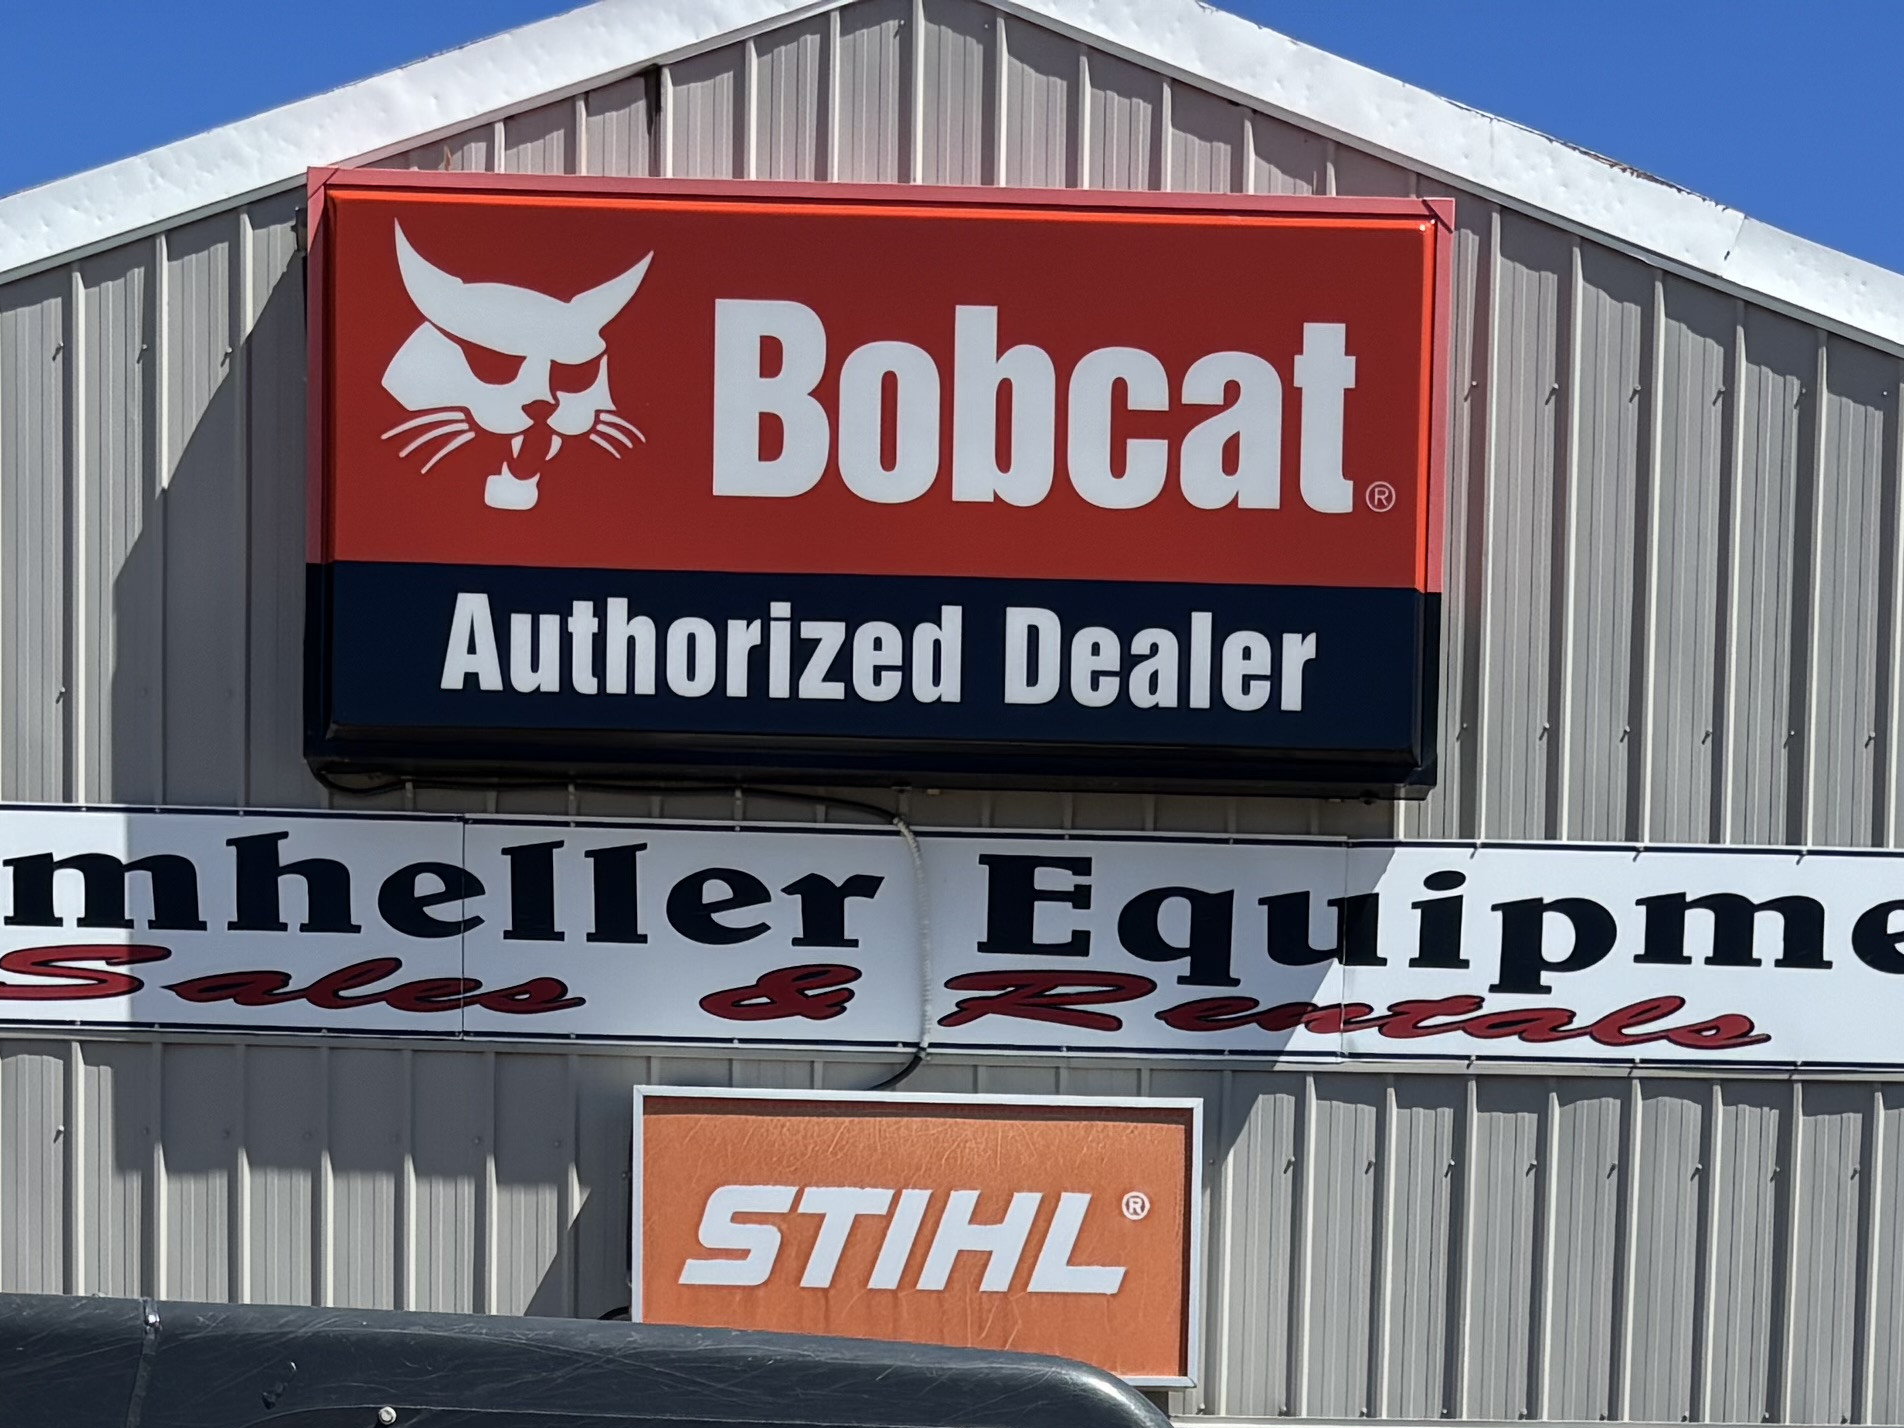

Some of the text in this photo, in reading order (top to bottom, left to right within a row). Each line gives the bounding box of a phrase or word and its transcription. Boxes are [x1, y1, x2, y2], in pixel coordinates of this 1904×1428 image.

[712, 298, 1356, 514] Bobcat
[440, 592, 1318, 712] Authorized Dealer
[937, 968, 1772, 1049] Rentals
[678, 1184, 1126, 1294] STIHL
